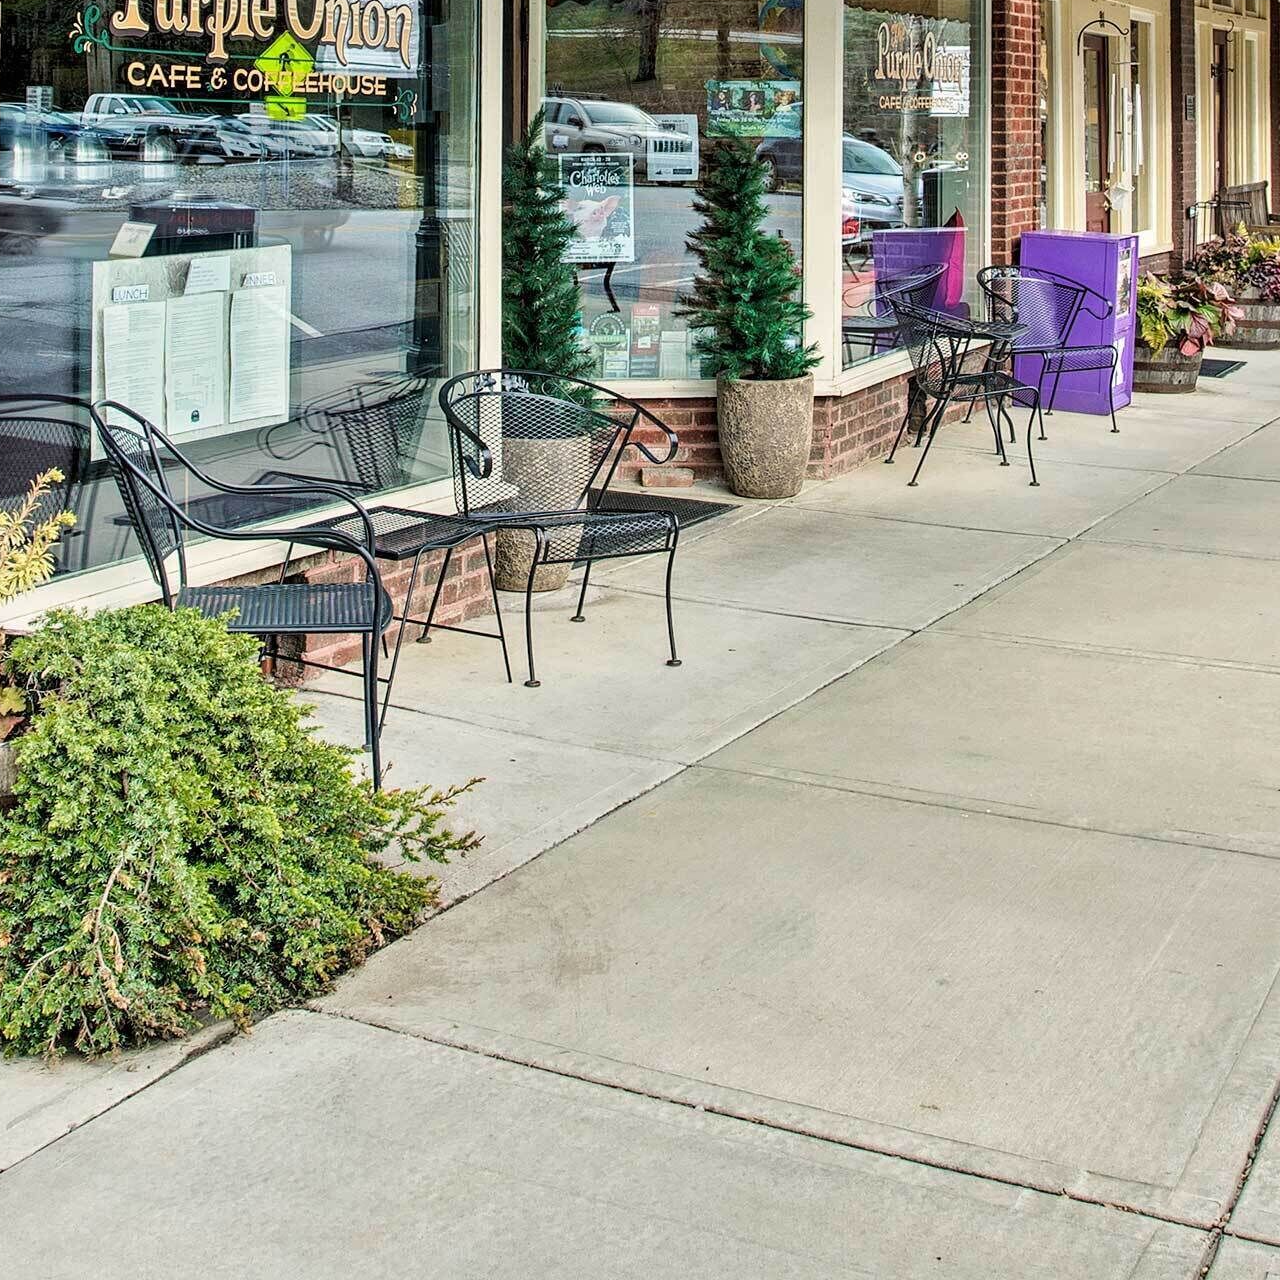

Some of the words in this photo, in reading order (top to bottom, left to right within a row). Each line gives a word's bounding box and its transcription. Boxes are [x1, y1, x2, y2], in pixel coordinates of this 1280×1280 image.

[875, 22, 922, 93] Purple
[924, 31, 963, 94] Onion
[127, 62, 202, 90] CAFE
[211, 68, 228, 91] &
[234, 68, 388, 97] COFFEEHOUSE
[879, 95, 901, 110] CAFE
[570, 169, 620, 188] Charlotte's
[586, 182, 607, 197] Web
[114, 288, 148, 302] LUNCH
